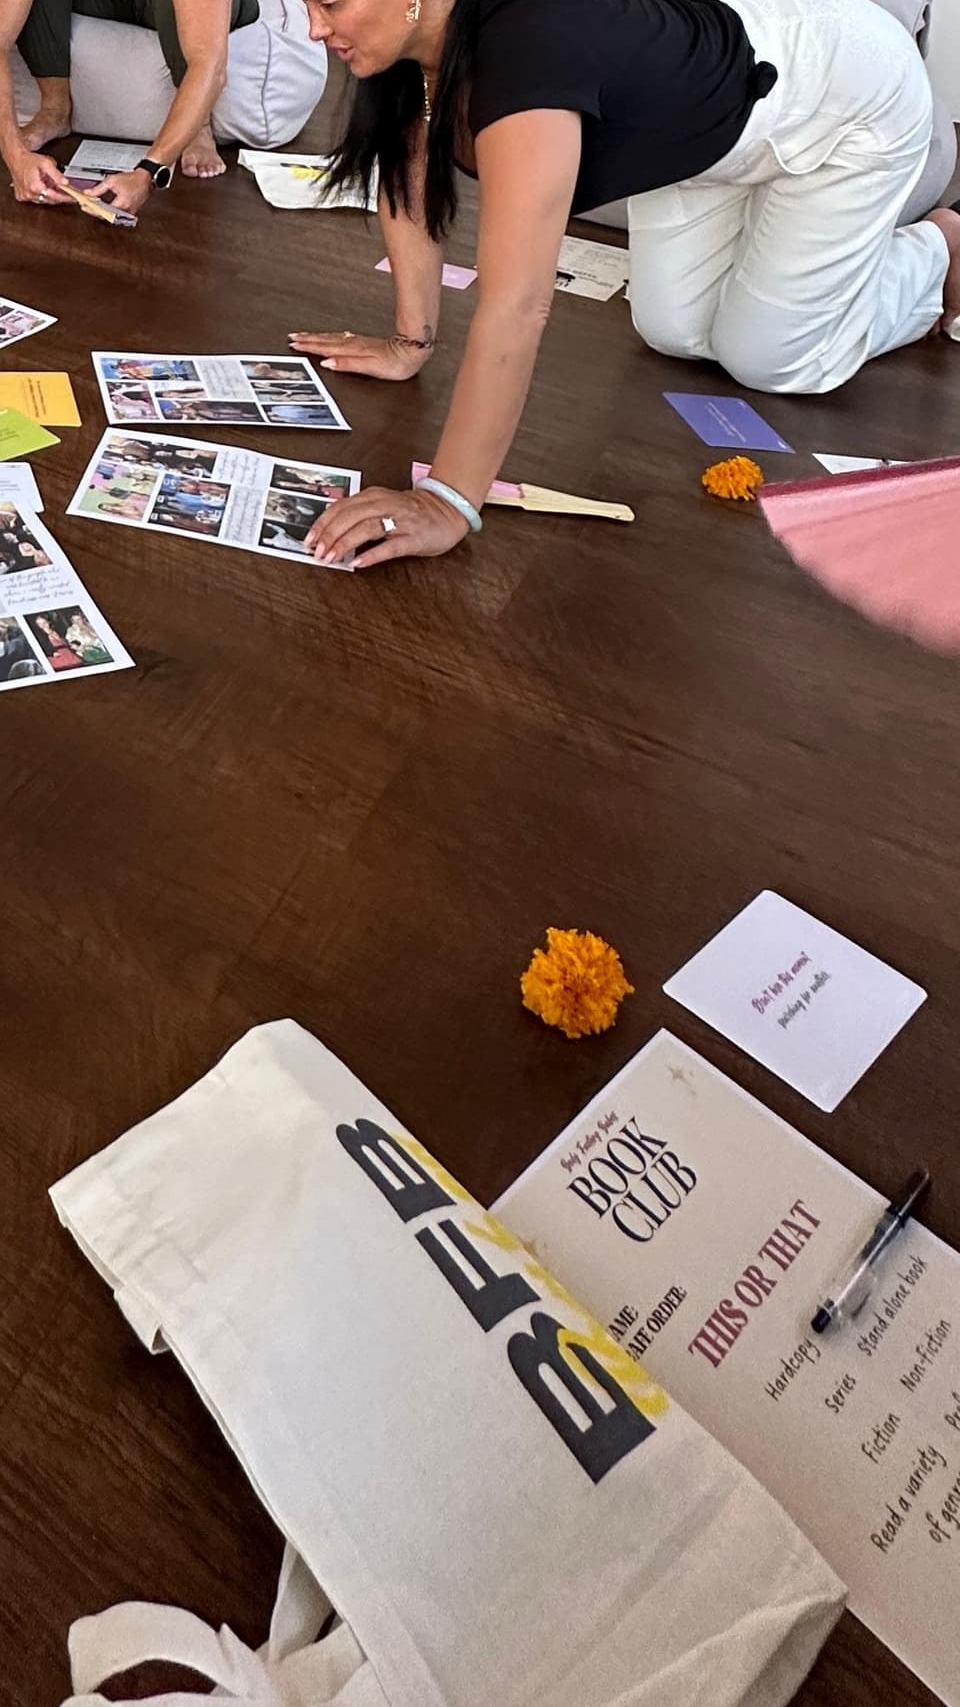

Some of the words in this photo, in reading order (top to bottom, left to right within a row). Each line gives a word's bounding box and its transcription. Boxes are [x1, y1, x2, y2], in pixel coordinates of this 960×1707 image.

[567, 1116, 668, 1219] BOOK
[612, 1151, 697, 1242] CLUB
[688, 1299, 749, 1368] THIS
[734, 1265, 778, 1308] OR
[758, 1199, 822, 1272] THAT
[896, 1255, 928, 1288] book
[608, 1305, 639, 1342] AME:
[626, 1326, 654, 1362] AFE
[646, 1285, 688, 1334] ORDER:
[883, 1283, 911, 1320] alone
[857, 1312, 889, 1357] Stand
[765, 1338, 822, 1402] Hardcopy
[825, 1373, 857, 1414] Series
[861, 1412, 901, 1465] Fiction
[905, 1445, 948, 1497] variety
[870, 1502, 905, 1554] Read
[898, 1496, 913, 1513] a
[925, 1510, 952, 1544] of
[941, 1470, 960, 1531] genr
